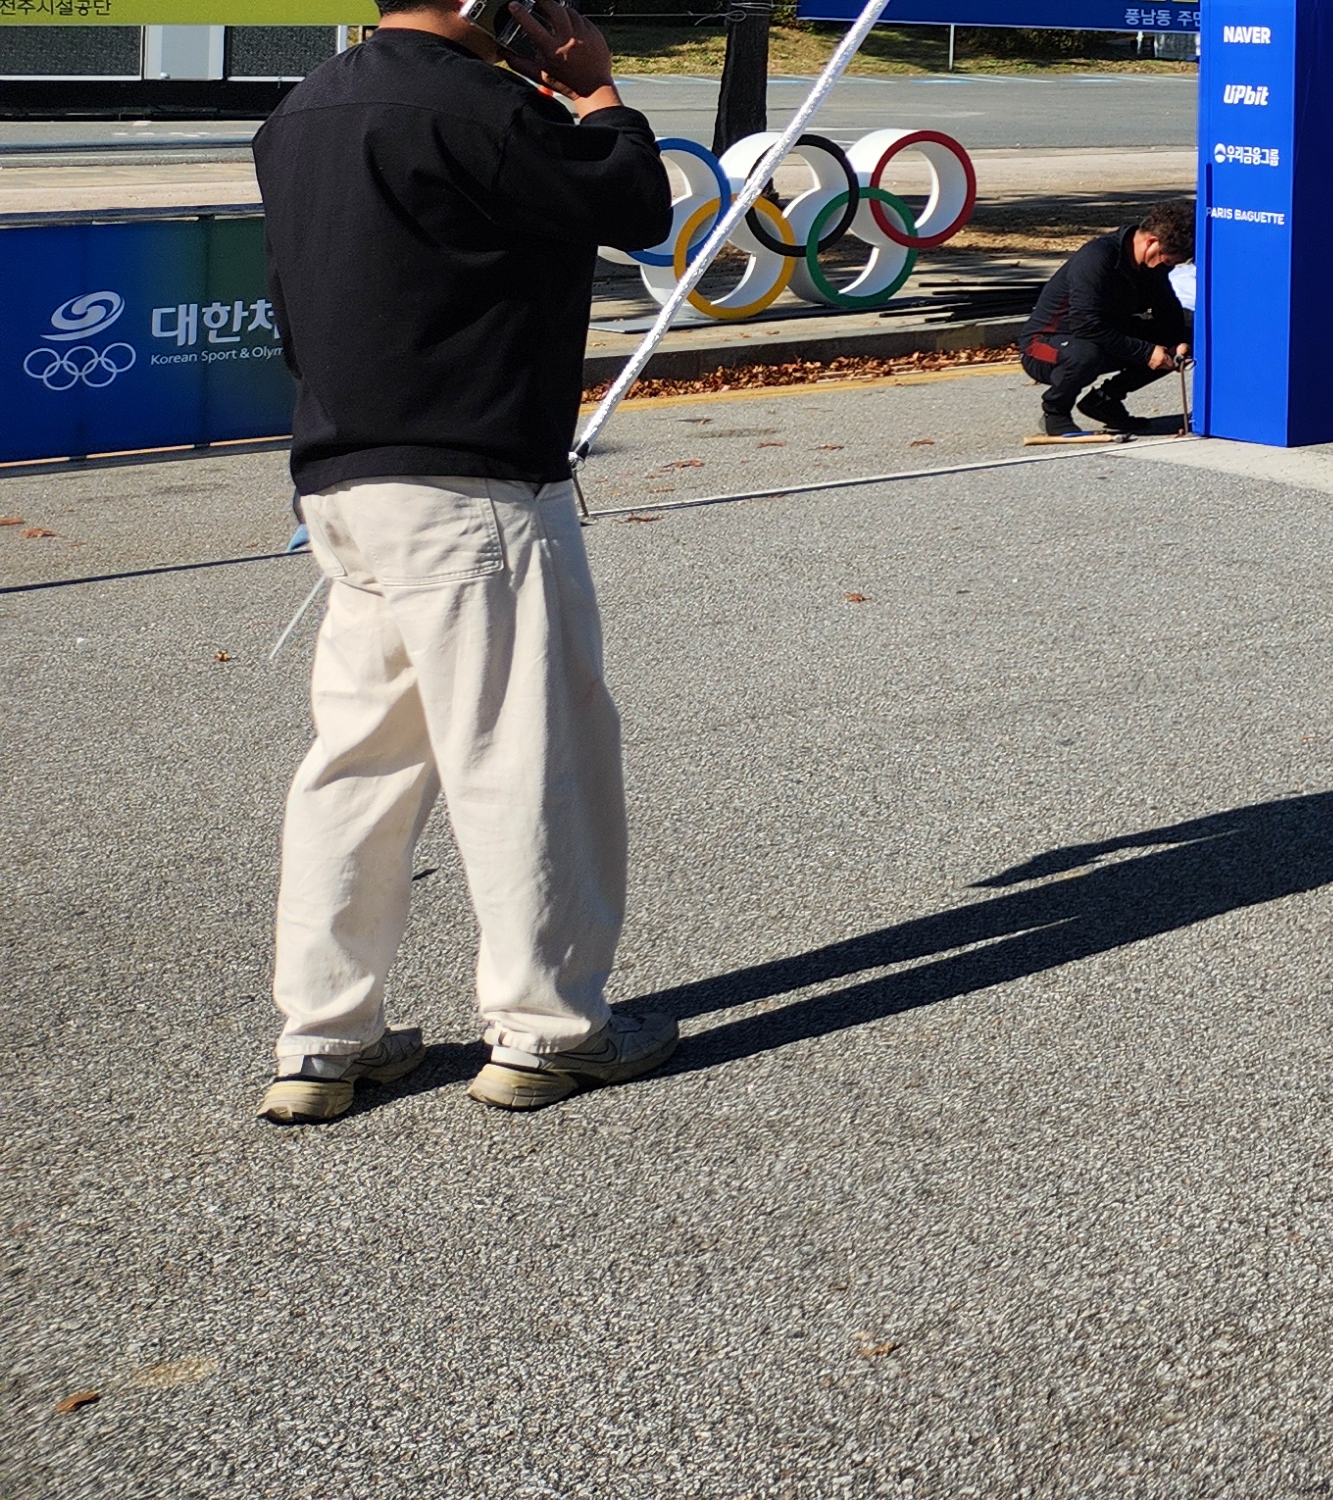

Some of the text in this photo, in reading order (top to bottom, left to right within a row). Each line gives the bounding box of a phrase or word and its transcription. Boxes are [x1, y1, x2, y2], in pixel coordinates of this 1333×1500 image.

[0, 0, 112, 16] 전주시설공단
[1124, 8, 1172, 27] 풍남동
[1223, 25, 1271, 44] NAVER
[1227, 145, 1280, 167] 우리금융그룹
[1206, 207, 1285, 225] PARIS BAGUETTE
[151, 354, 198, 365] Korean
[201, 350, 237, 363] Sport
[240, 347, 250, 358] &
